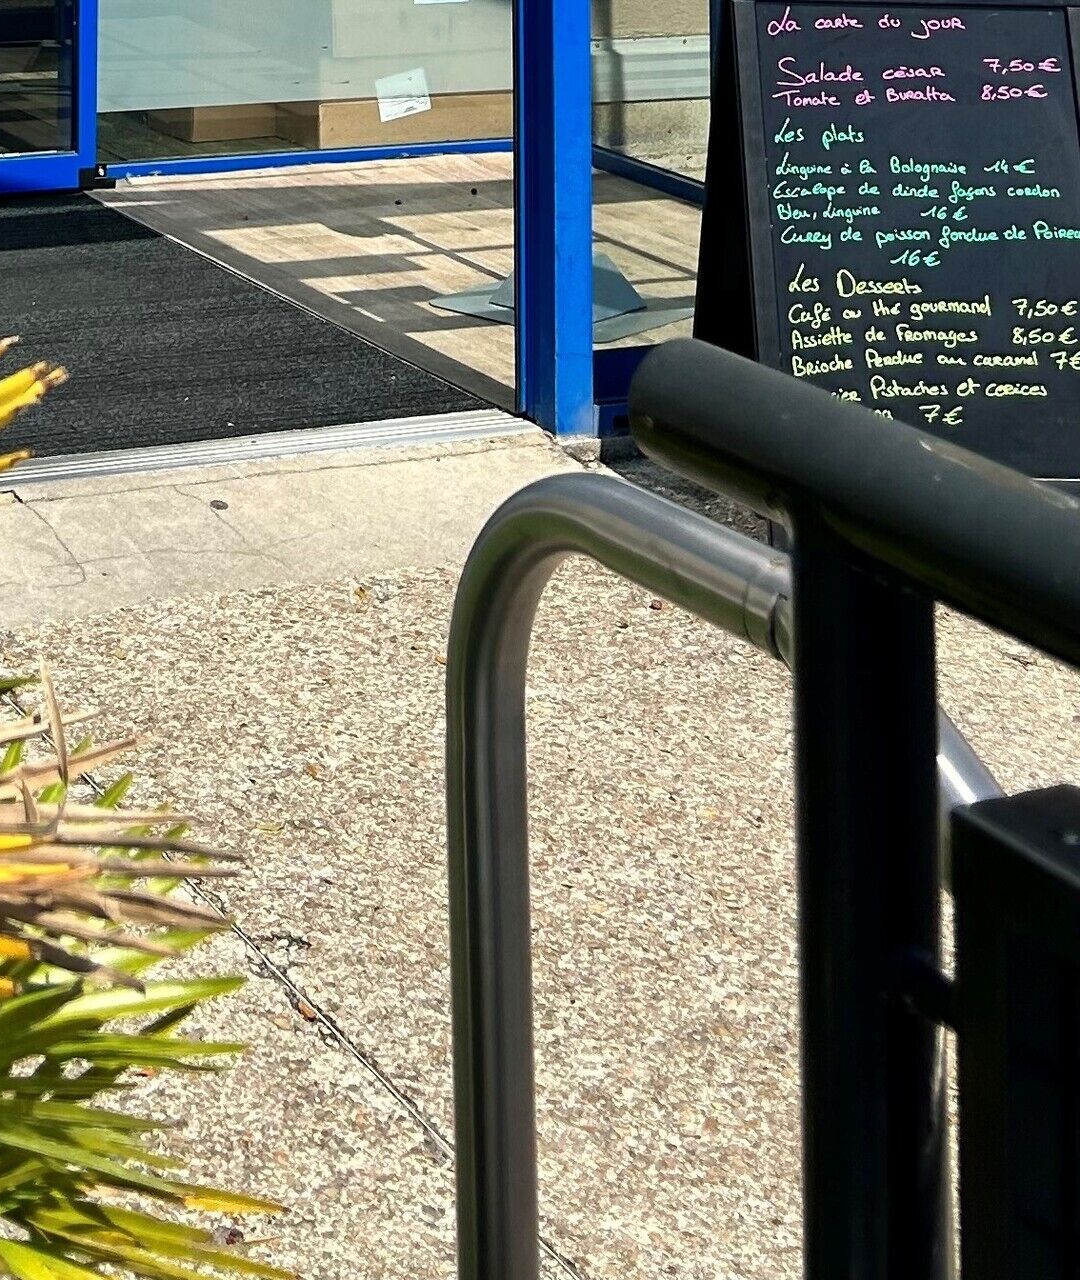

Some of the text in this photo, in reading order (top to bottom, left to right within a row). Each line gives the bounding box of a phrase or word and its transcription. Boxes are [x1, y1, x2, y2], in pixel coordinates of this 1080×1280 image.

[767, 5, 802, 36] La
[814, 13, 864, 30] carte
[877, 13, 901, 29] du
[776, 56, 865, 87] Salade
[771, 89, 841, 107] Tomate
[854, 89, 876, 106] et
[774, 117, 865, 151] Les plats
[775, 151, 833, 181] Linguine
[840, 162, 853, 175] à
[889, 155, 967, 184] Bolognaise
[772, 180, 846, 202] Escalope
[858, 181, 881, 195] de
[891, 183, 940, 199] dinde
[1006, 183, 1061, 198] cordon
[780, 224, 832, 250] Curry
[839, 225, 863, 242] de
[875, 228, 931, 249] poisson
[938, 225, 1000, 249] fondue
[1002, 224, 1028, 240] de
[788, 262, 923, 298] Les Desserts
[787, 302, 832, 329] Café
[842, 308, 862, 320] ou
[872, 298, 901, 317] thé
[909, 294, 992, 321] gourmand
[791, 325, 854, 350] Assiette
[864, 325, 887, 343] de
[791, 353, 854, 377] Brioche
[864, 348, 923, 369] Perdue
[936, 354, 968, 366] au
[972, 350, 1039, 367] caramel
[869, 374, 949, 400] Pistaches
[956, 377, 981, 397] et
